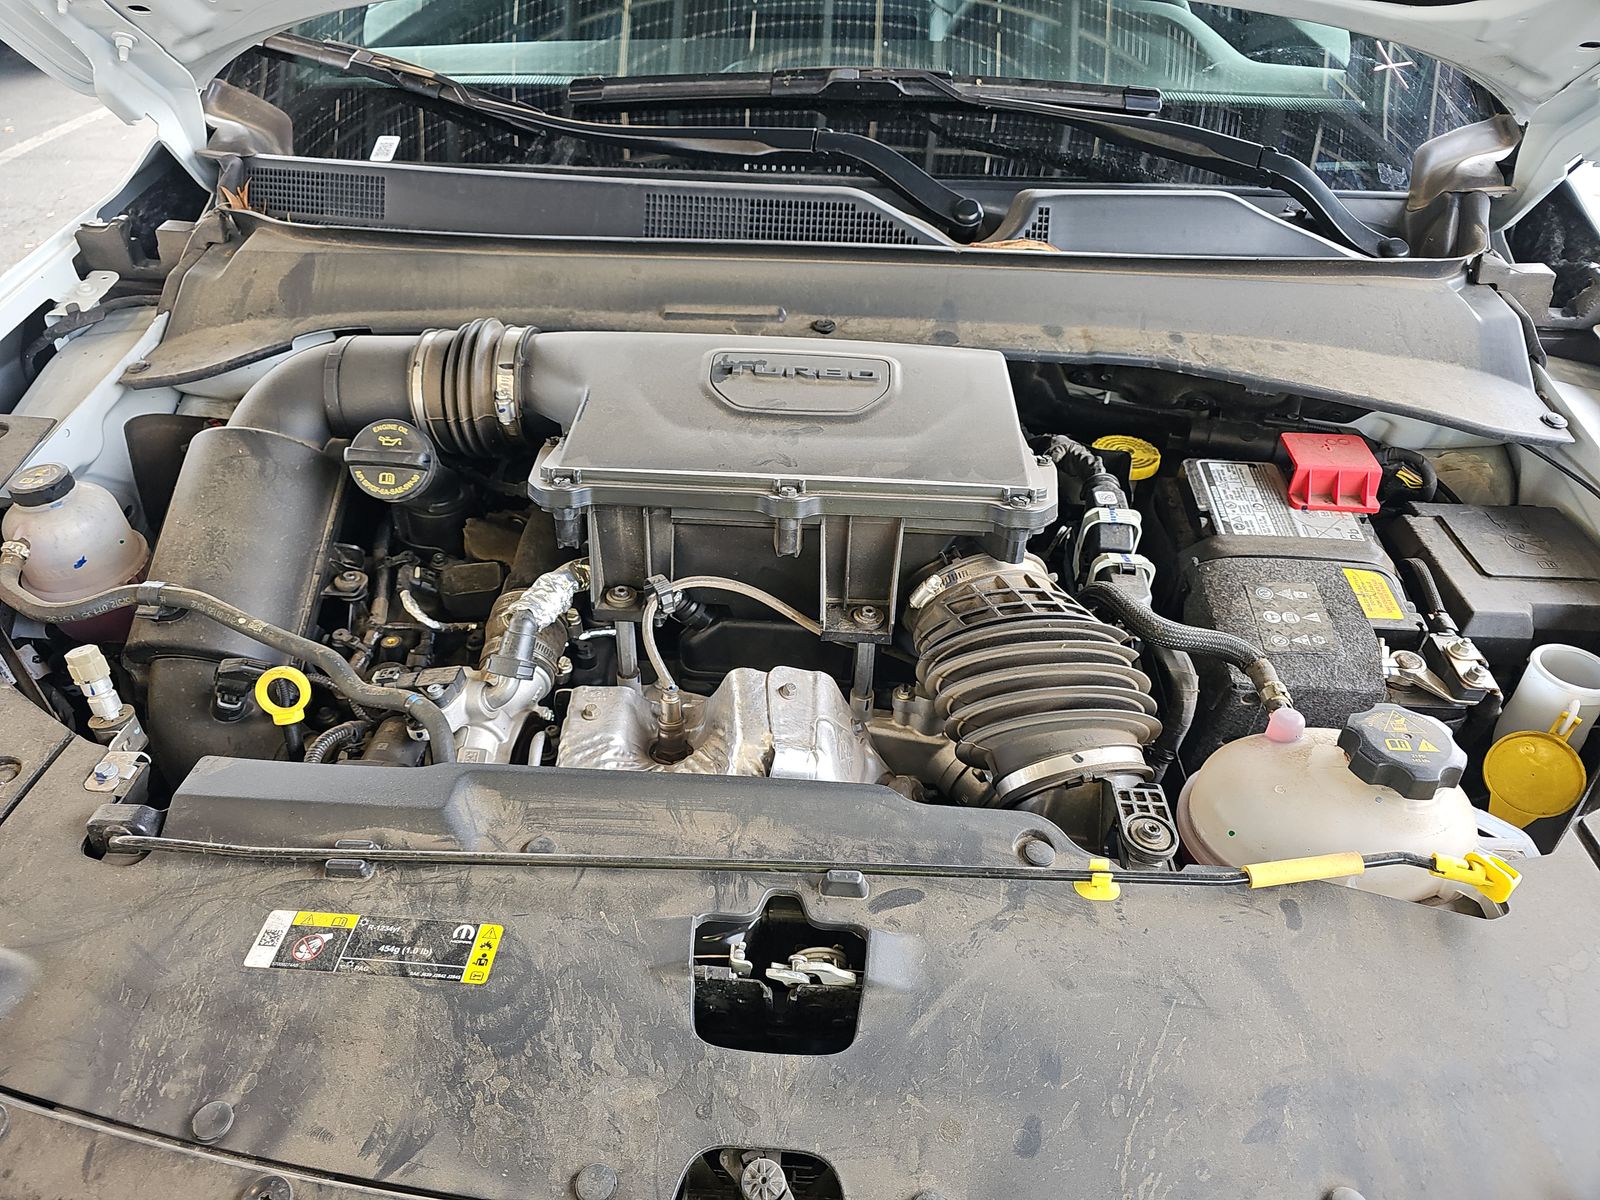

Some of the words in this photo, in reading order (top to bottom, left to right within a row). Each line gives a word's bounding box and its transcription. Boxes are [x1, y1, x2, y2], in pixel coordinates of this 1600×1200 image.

[722, 360, 882, 382] TURBO
[372, 424, 398, 433] ENGINE
[398, 426, 409, 435] OIL
[378, 945, 401, 955] 454g
[401, 946, 420, 956] (1.0
[420, 947, 433, 957] lb)
